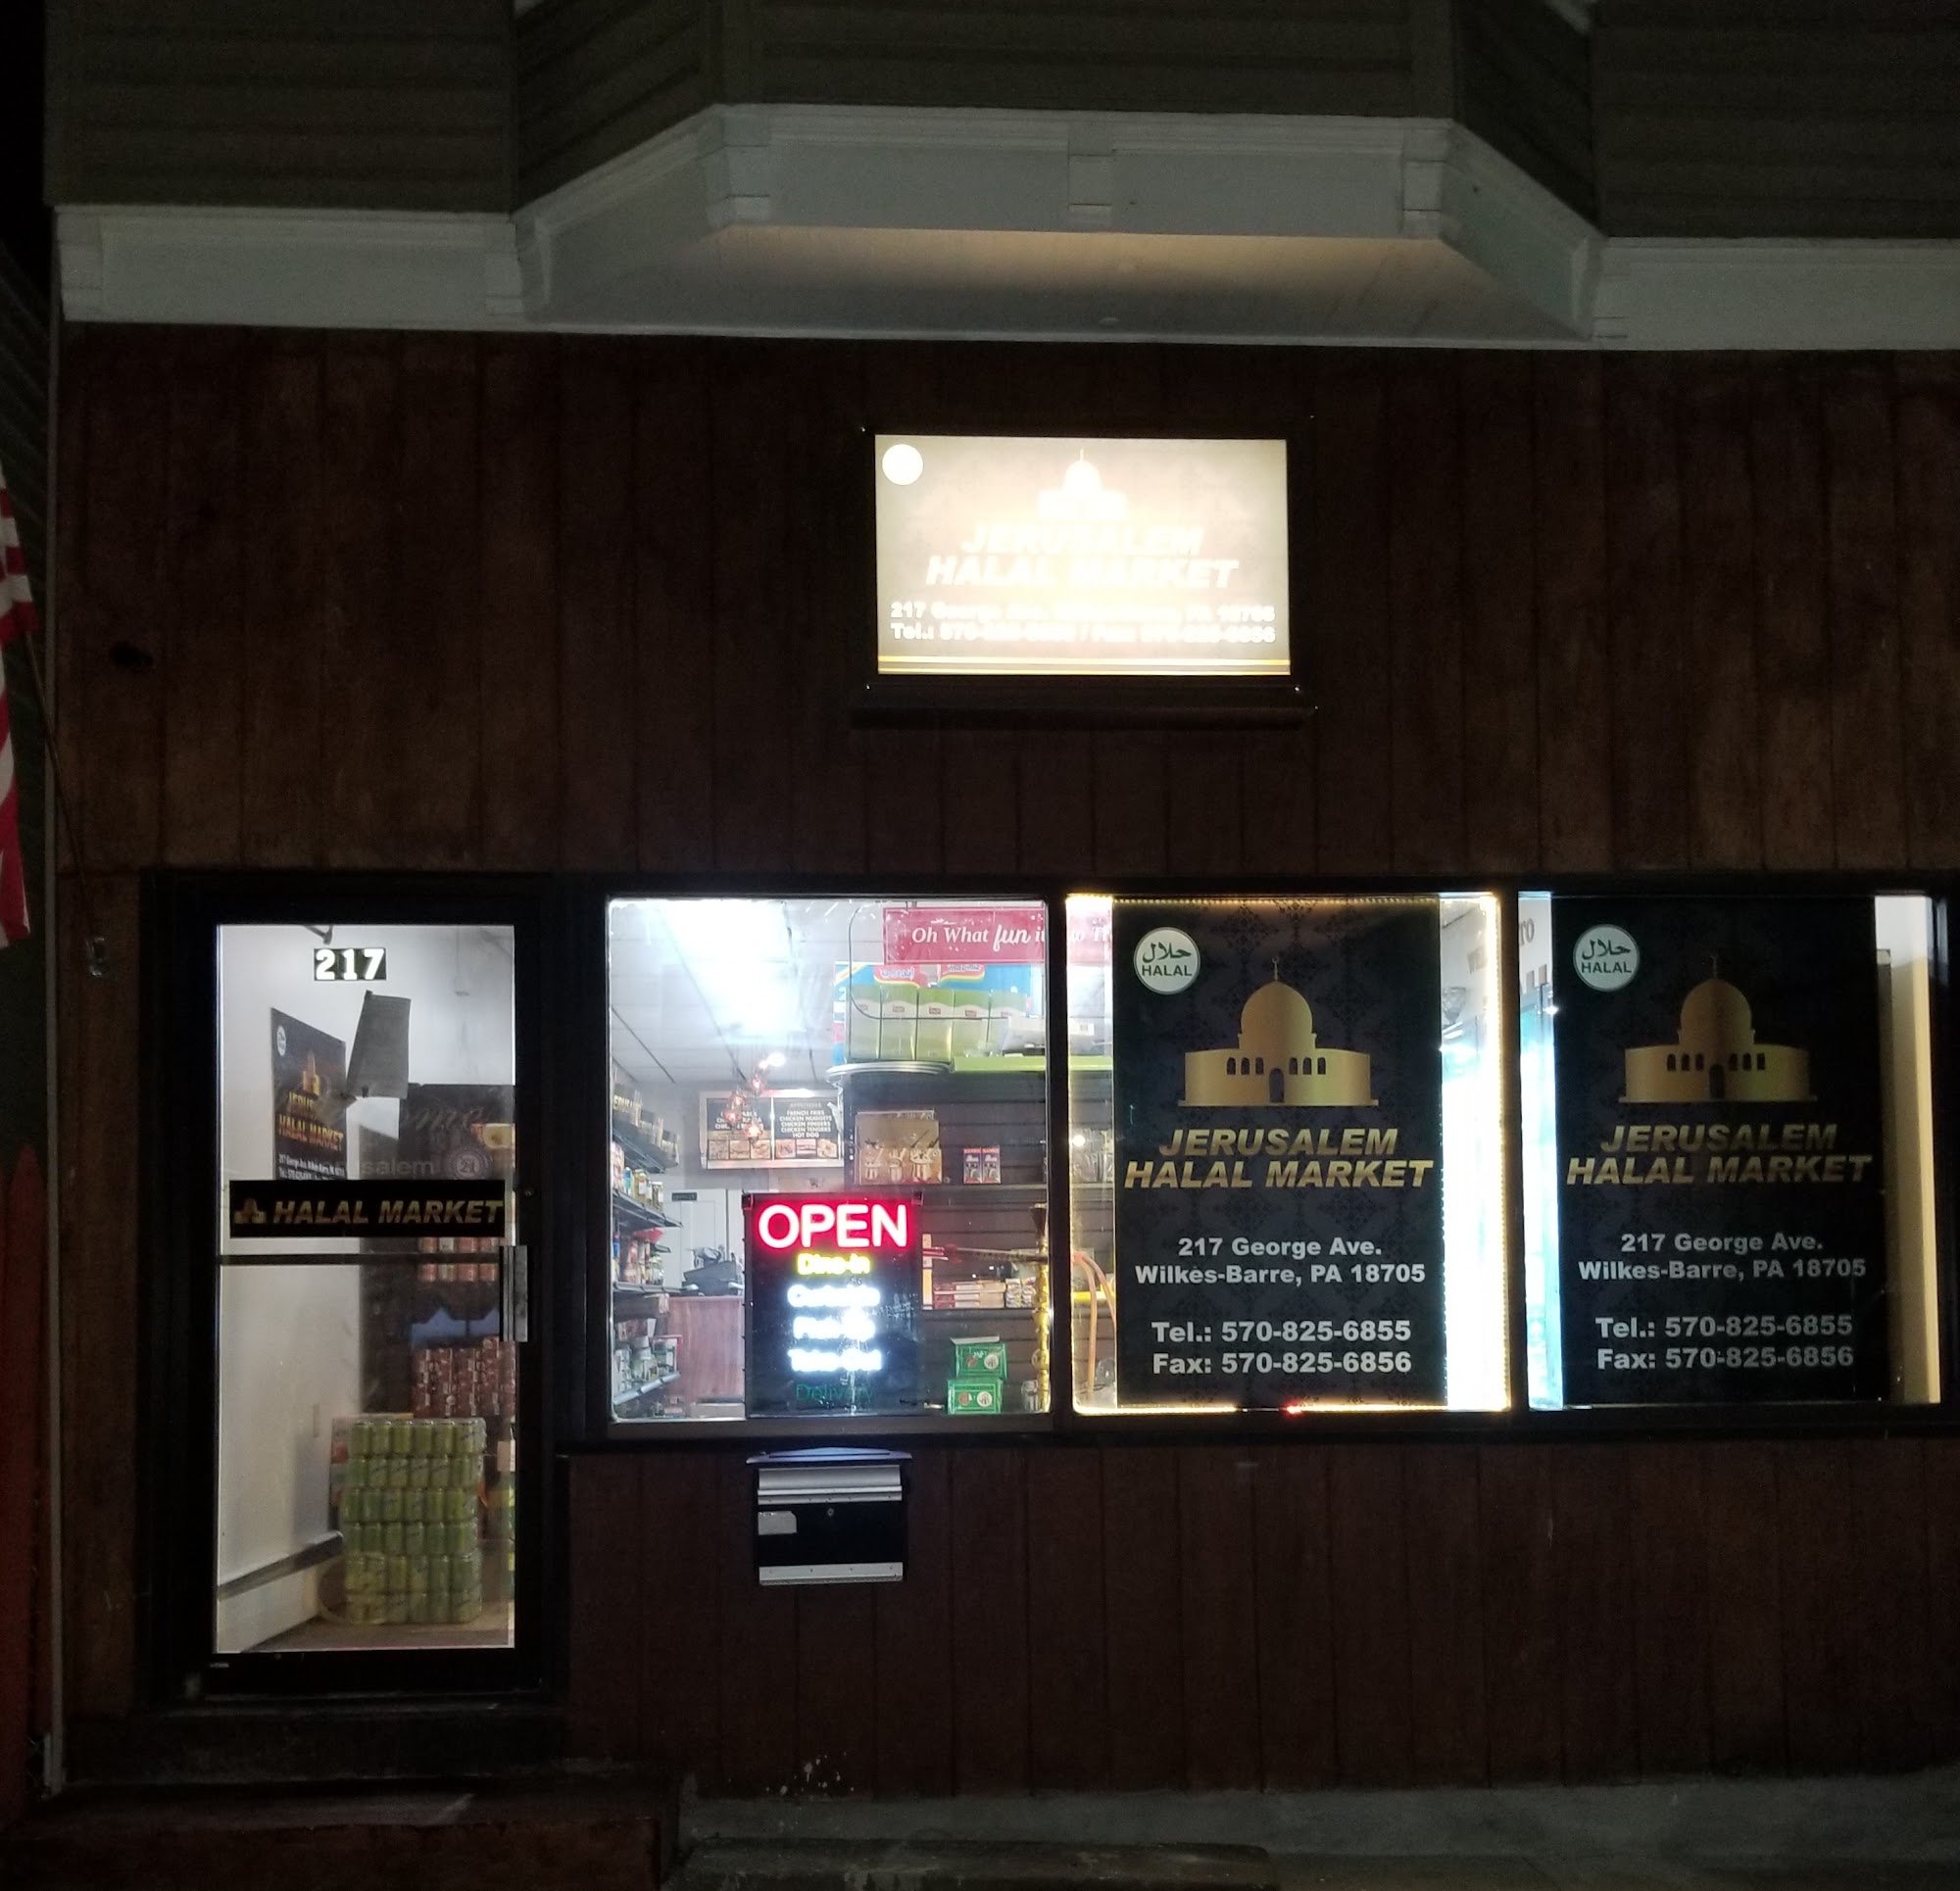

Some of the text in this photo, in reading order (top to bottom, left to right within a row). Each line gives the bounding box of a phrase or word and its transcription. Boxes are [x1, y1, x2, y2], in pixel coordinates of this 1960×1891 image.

[926, 555, 1240, 589] HALAL MARKET
[890, 601, 925, 619] 217
[911, 926, 938, 944] Oh
[944, 926, 989, 944] What
[993, 924, 1032, 952] fun
[1582, 938, 1632, 960] حلال
[1142, 941, 1192, 964] حلال
[315, 948, 385, 981] 217
[1142, 964, 1193, 977] HALAL
[1581, 961, 1633, 974] HALAL
[1159, 1127, 1398, 1157] JERUSALEM
[1600, 1123, 1838, 1153] JERUSALEM
[1124, 1159, 1434, 1188] HALAL MARKET
[1566, 1155, 1873, 1185] HALAL MARKET
[272, 1199, 505, 1225] HALAL MARKET
[759, 1203, 908, 1249] OPEN
[1178, 1237, 1383, 1260] 217 George Ave.
[1620, 1234, 1824, 1255] 217 George Ave.
[1134, 1264, 1426, 1287] Wilkes-Barre, PA 18705
[1578, 1259, 1867, 1282] Wilkes-Barre, PA 18705
[1152, 1320, 1411, 1342] Tel.: 570-825-6855
[1595, 1316, 1853, 1338] Tel.: 570-825-6855
[1152, 1352, 1412, 1375] Fax: 570-825-6856
[1596, 1346, 1854, 1370] Fax: 570-825-6856
